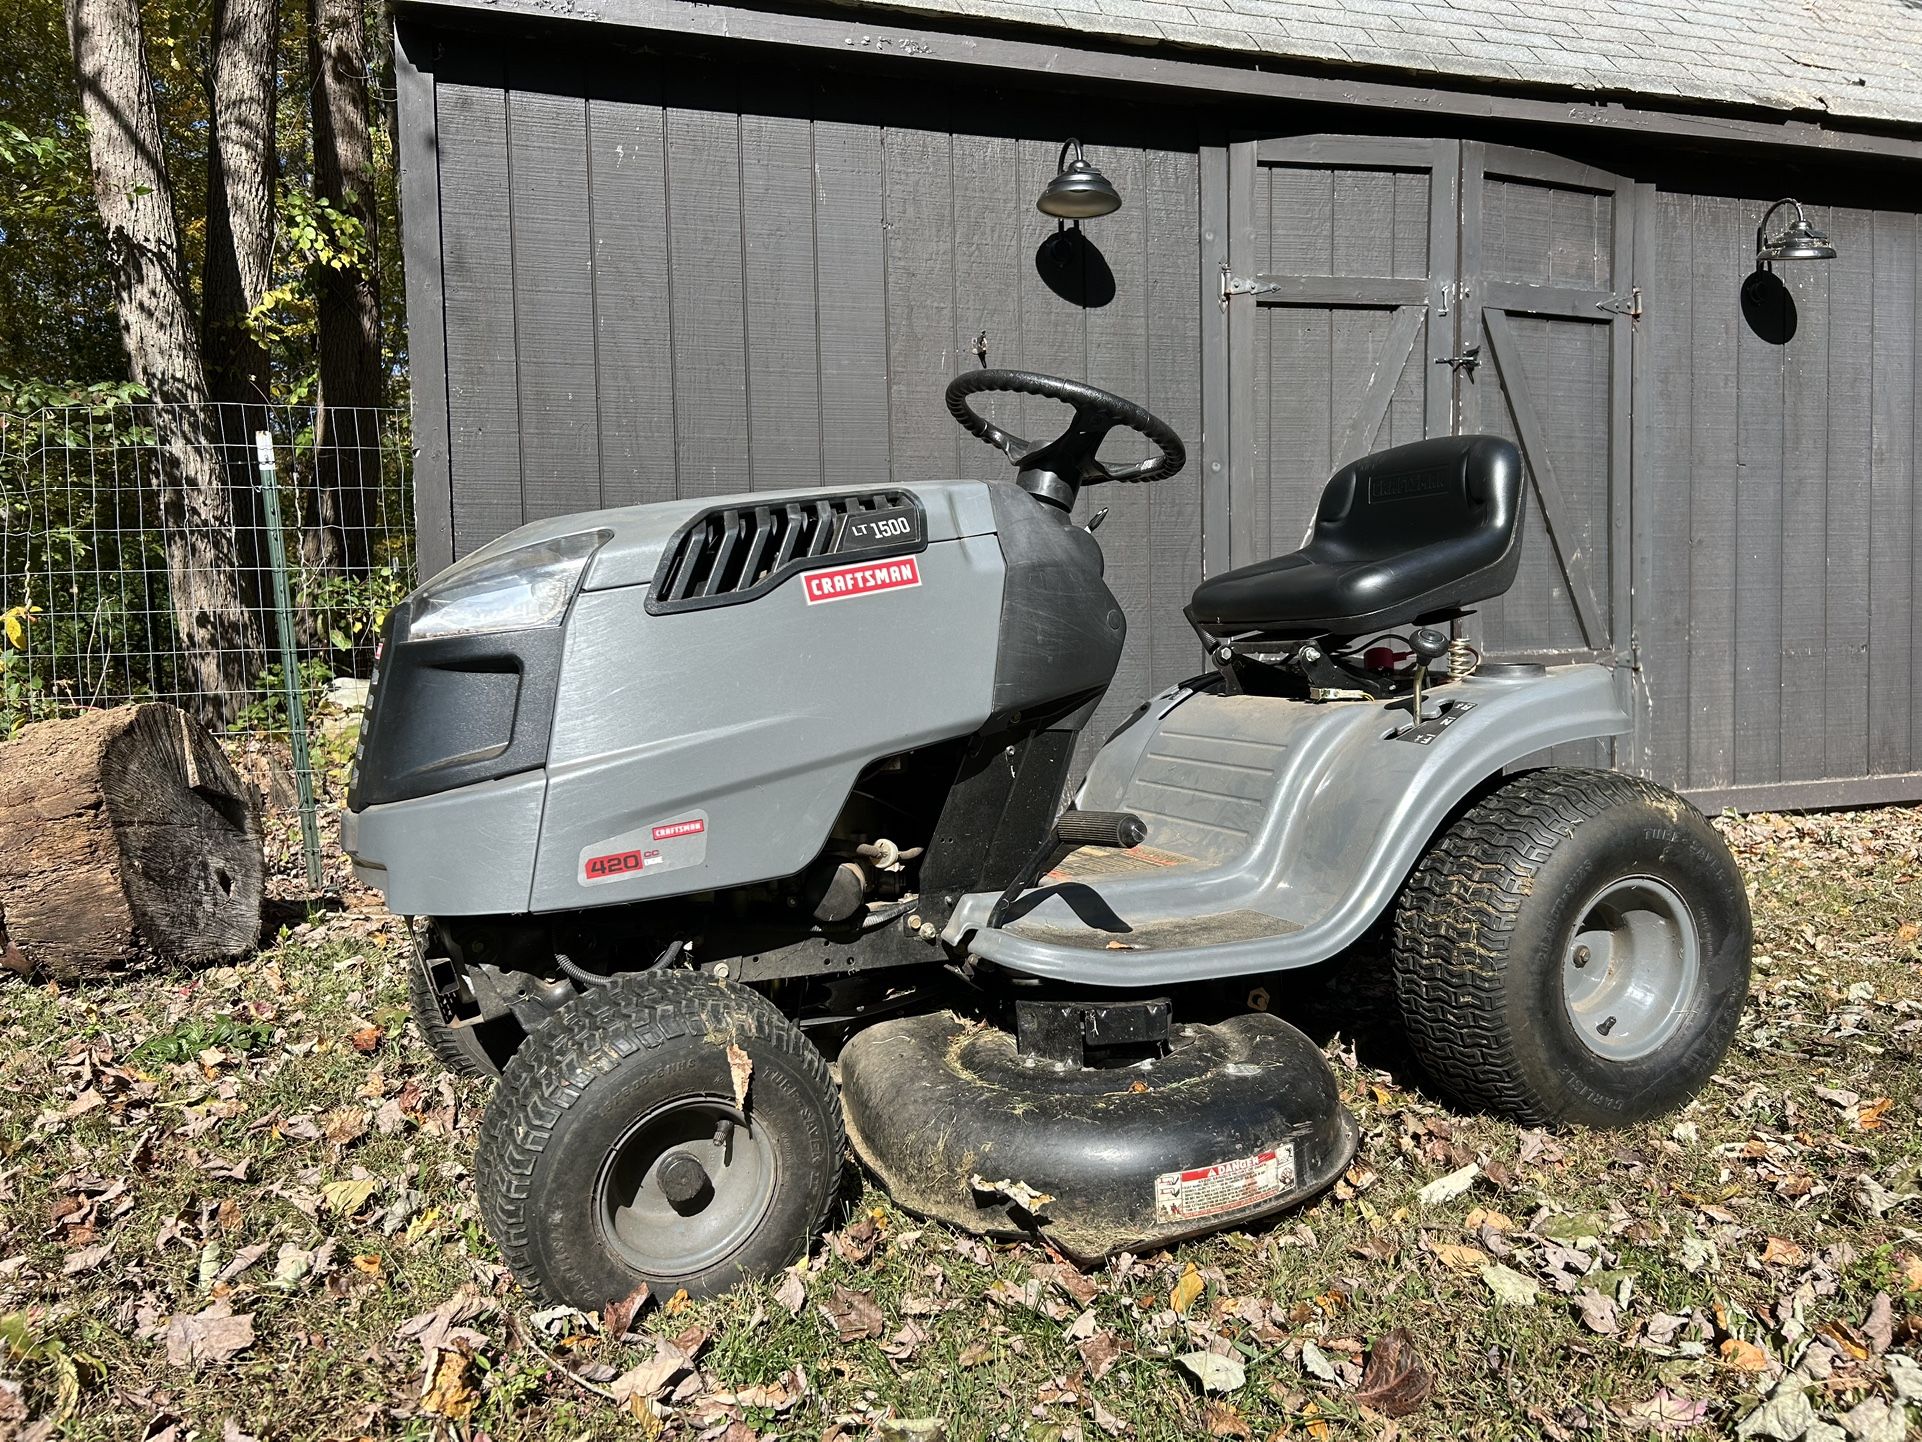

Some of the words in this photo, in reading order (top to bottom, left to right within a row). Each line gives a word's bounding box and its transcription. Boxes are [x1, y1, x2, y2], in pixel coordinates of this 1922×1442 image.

[852, 524, 868, 537] LT
[870, 517, 911, 539] 1500
[810, 564, 913, 596] CRAFTSMAN
[655, 823, 701, 838] CRAFTSMAN
[591, 854, 640, 874] 420
[1217, 1155, 1259, 1175] DANGER
